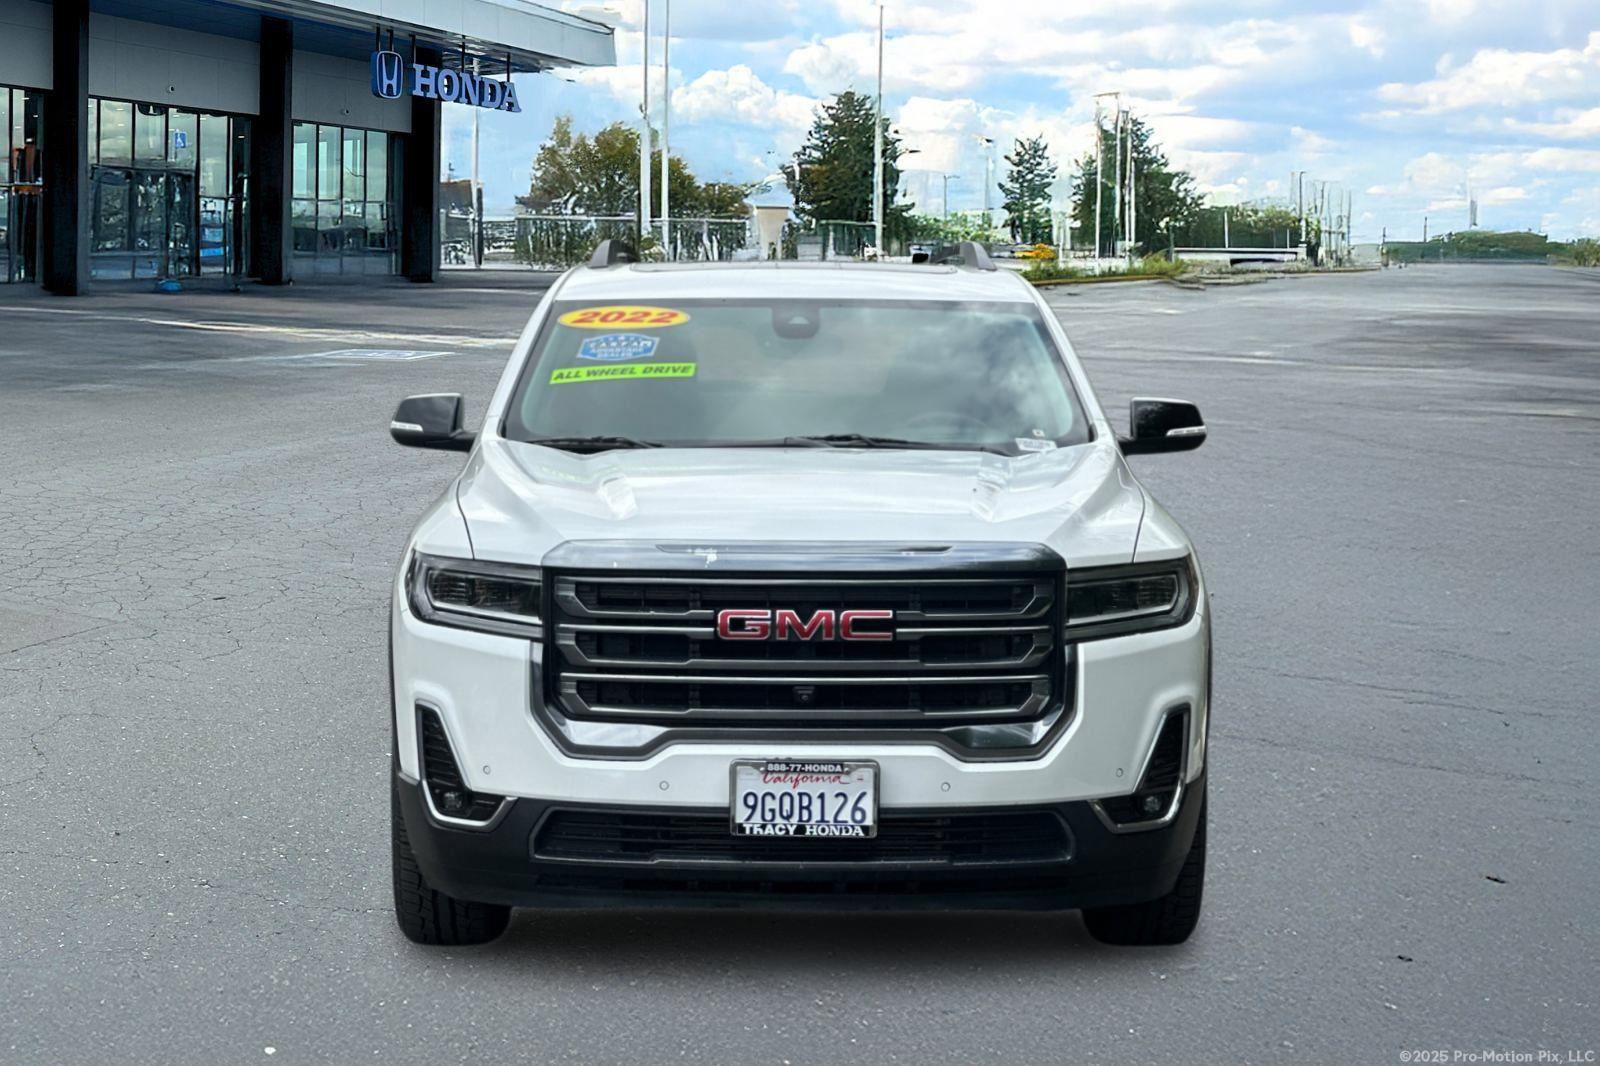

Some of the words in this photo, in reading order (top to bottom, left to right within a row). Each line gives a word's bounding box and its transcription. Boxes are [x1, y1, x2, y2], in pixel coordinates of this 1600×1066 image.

[412, 63, 522, 113] HONDA
[572, 310, 679, 324] 2022
[553, 370, 582, 381] ALL
[586, 367, 638, 378] WHEEL
[642, 365, 692, 375] DRIVE
[717, 609, 893, 641] GMC
[767, 763, 843, 773] 888-77-HONDA
[761, 771, 851, 790] California
[742, 791, 868, 825] 9GQB126
[743, 823, 798, 836] TRACY
[804, 824, 866, 837] HONDA
